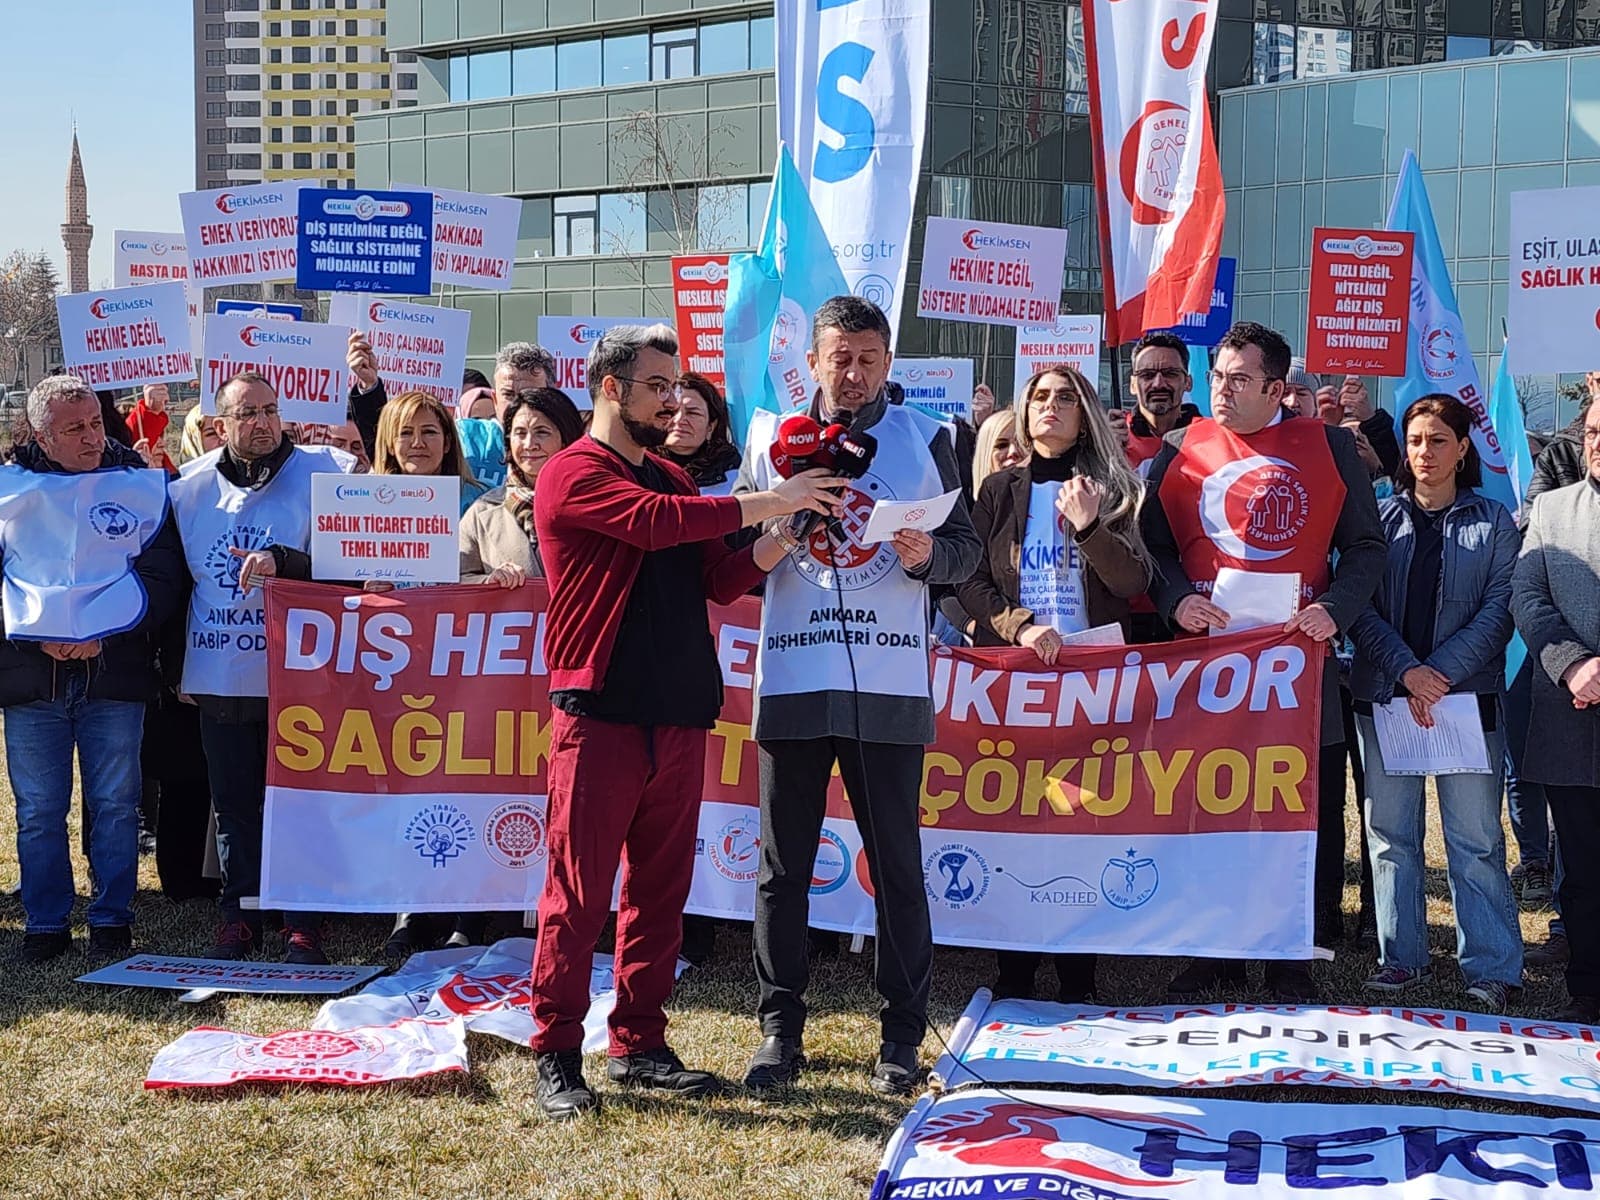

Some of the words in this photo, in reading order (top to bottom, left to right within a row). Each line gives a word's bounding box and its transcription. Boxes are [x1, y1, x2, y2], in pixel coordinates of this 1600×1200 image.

[228, 193, 283, 209] HEKİMSEN
[435, 200, 488, 216] HEKİMSEN
[200, 223, 235, 246] EMEK
[236, 215, 299, 242] VERİYORU
[305, 220, 327, 238] DİŞ
[329, 221, 388, 238] HEKİMİNE
[390, 223, 427, 240] DEĞİL,
[435, 220, 483, 247] DAKİKADA
[310, 238, 354, 255] SAĞLIK
[356, 240, 421, 257] SİSTEMİNE
[975, 233, 1031, 250] HEKİMSEN
[1523, 236, 1561, 264] EŞİT,
[130, 263, 169, 279] HASTA
[193, 253, 255, 279] HAKKIMIZI
[257, 246, 297, 272] İSTİYO
[316, 257, 381, 274] MÜDAHALE
[383, 259, 416, 275] EDİN!
[1330, 263, 1357, 277] HIZLI
[1359, 262, 1394, 281] DEĞİL,
[949, 255, 994, 284] HEKİME
[998, 258, 1034, 292] DEĞİL,
[1521, 265, 1585, 289] SAĞLIK
[1335, 280, 1387, 296] NİTELİKLİ
[101, 297, 154, 314] HEKİMSEN
[678, 290, 712, 306] MESLEK
[714, 290, 728, 308] AŞ
[921, 285, 966, 314] SİSTEME
[969, 290, 1026, 320] MÜDAHALE
[1028, 296, 1057, 323] EDİN!
[1335, 297, 1361, 312] AĞIZ
[1363, 298, 1384, 316] DİŞ
[379, 308, 435, 325] HEKİMSEN
[690, 312, 725, 328] YANIYO
[1315, 315, 1355, 330] TEDAVİ
[1356, 316, 1402, 333] HİZMETİ
[85, 319, 128, 352] HEKİME
[130, 317, 166, 347] DEĞİL,
[253, 331, 312, 346] HEKİMSEN
[377, 331, 395, 352] DIŞI
[396, 334, 445, 356] ÇALIŞMADA
[696, 332, 725, 351] SİSTE
[1326, 332, 1389, 350] İSTİYORUZ!
[1020, 343, 1055, 356] MESLEK
[1057, 343, 1095, 358] AŞKIYLA
[68, 359, 110, 386] SİSTEME
[112, 354, 165, 382] MÜDAHALE
[166, 348, 193, 375] EDİN!
[406, 357, 442, 378] ESASTIR
[208, 353, 331, 402] TÜİYORUZ
[903, 385, 946, 399] EKİMLİĞİ
[918, 400, 967, 413] ESLEKTİR.
[787, 433, 815, 445] NOW
[343, 488, 370, 496] HEKİM
[401, 489, 427, 498] BİRLİĞİ
[318, 512, 361, 533] SAĞLIK
[363, 513, 414, 534] TİCARET
[416, 514, 453, 537] DEĞİL,
[340, 540, 378, 558] TEMEL
[381, 541, 430, 559] HAKTIR!
[808, 607, 878, 625] ANKARA
[192, 630, 230, 650] TABİP
[284, 595, 413, 691] DİŞ
[767, 628, 870, 651] DİŞHEKİMLERİ
[876, 631, 921, 650] ODASI
[275, 695, 552, 777] SAĞLIK
[919, 737, 1308, 826] ÇÖKÜYOR
[1030, 890, 1098, 904] KADHED
[124, 965, 225, 977] VARDİYA
[1126, 1026, 1539, 1057] SENDİKASI
[890, 1177, 984, 1200] HEKİM
[993, 1177, 1030, 1192] VE
[1038, 1178, 1126, 1200] DİĞ
